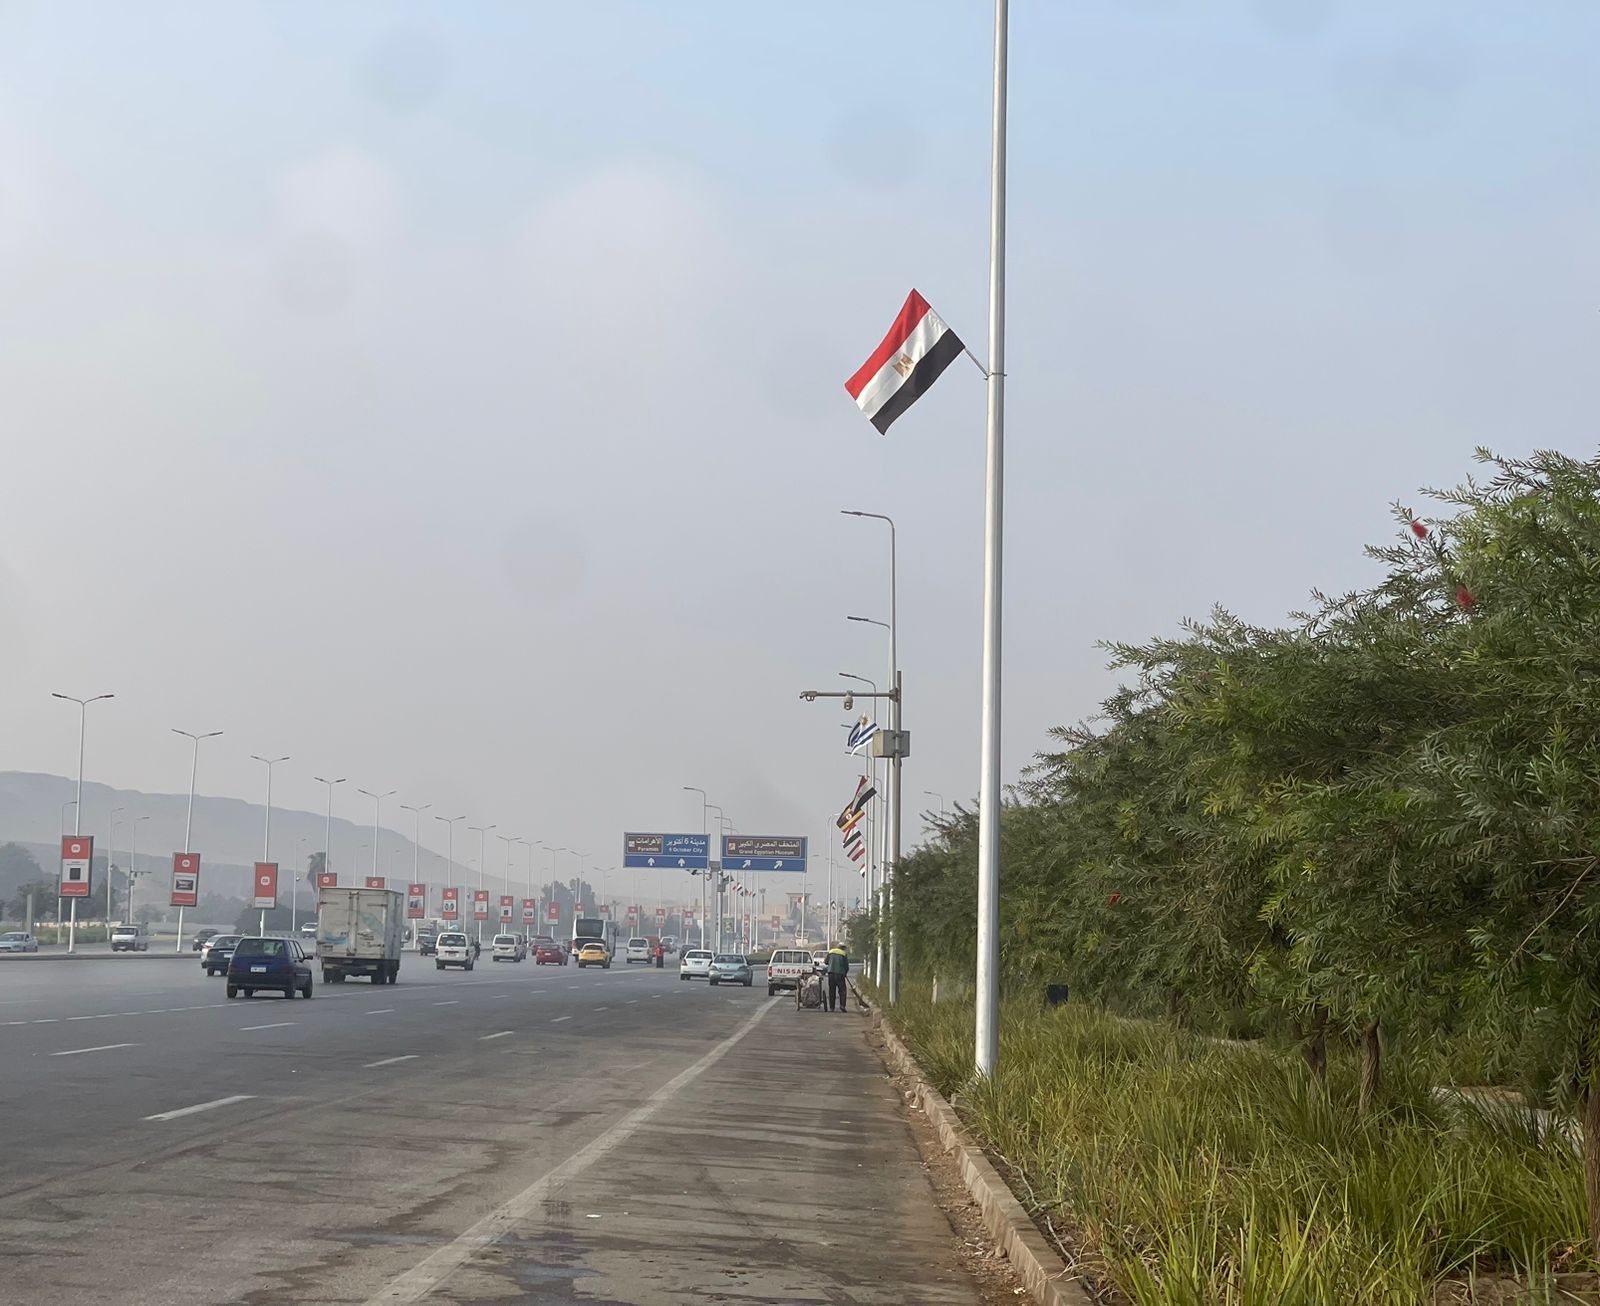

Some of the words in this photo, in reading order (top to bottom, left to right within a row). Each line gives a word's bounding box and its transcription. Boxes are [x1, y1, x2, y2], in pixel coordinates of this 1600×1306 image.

[666, 836, 683, 846] أكتوبر
[690, 838, 705, 846] مدينة
[738, 840, 753, 848] الكبير
